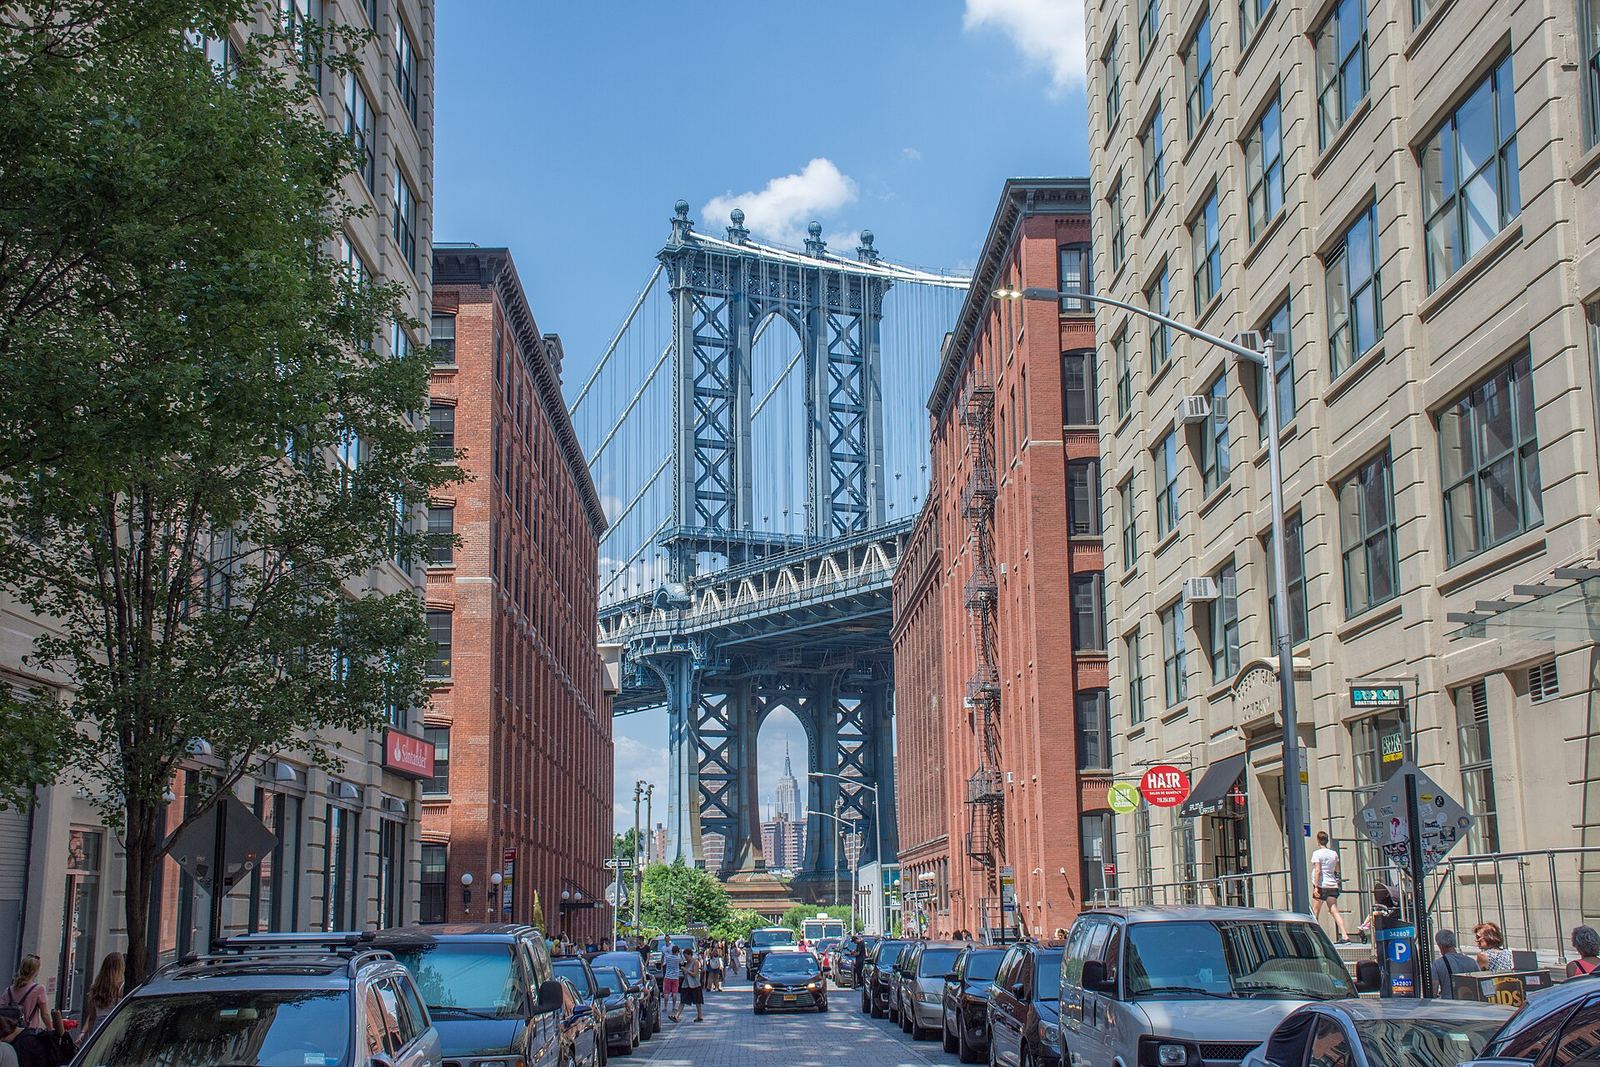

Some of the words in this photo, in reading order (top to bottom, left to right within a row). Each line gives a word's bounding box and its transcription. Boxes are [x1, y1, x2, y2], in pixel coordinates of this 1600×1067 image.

[1353, 688, 1400, 701] BROOKLYN
[401, 743, 427, 768] Santander
[1147, 772, 1182, 790] HAIR
[1395, 942, 1406, 960] P
